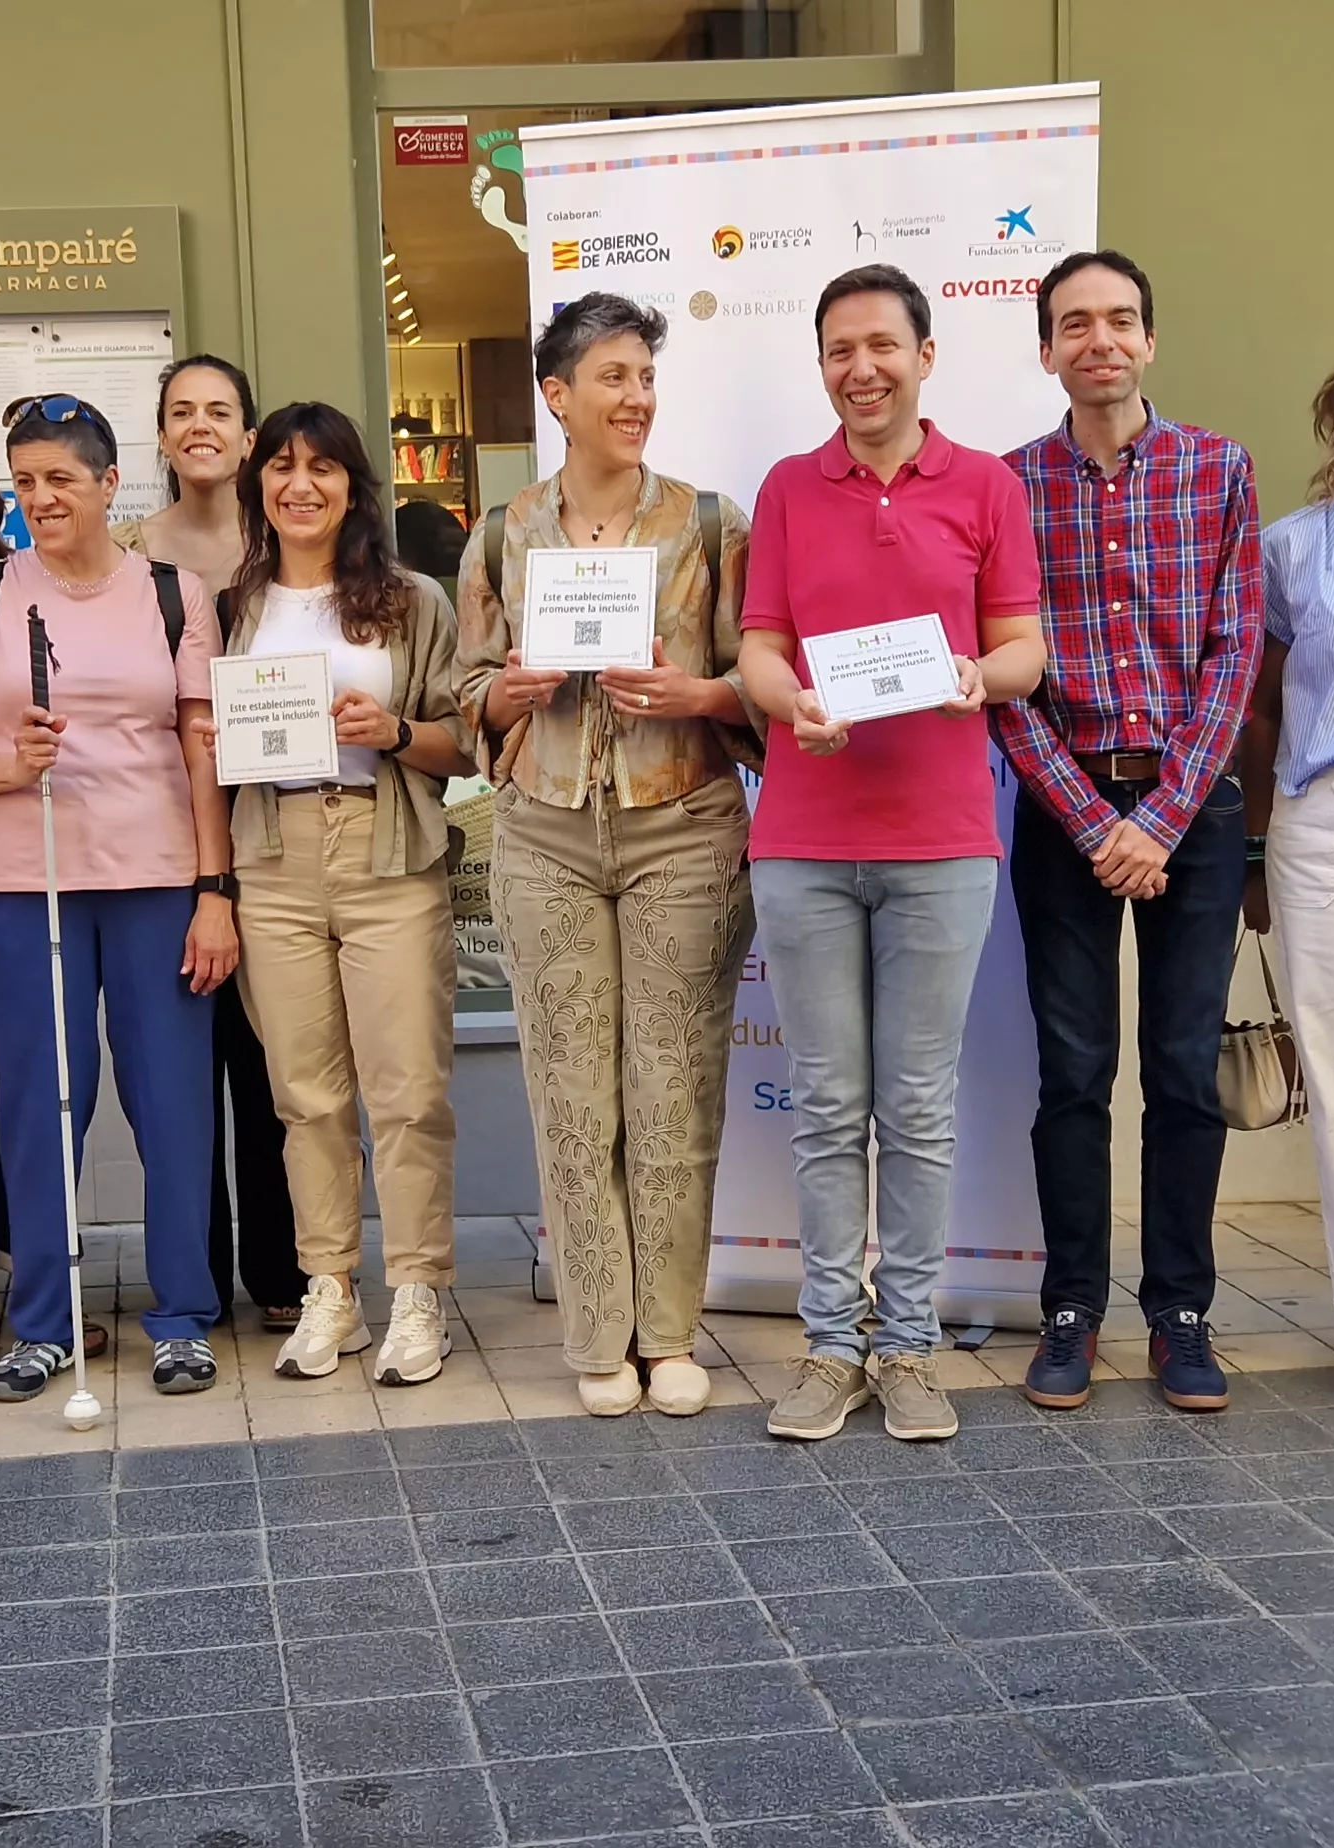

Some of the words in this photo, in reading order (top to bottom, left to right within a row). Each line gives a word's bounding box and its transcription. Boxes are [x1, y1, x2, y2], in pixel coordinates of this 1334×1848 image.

[419, 132, 464, 142] COMERCIO
[419, 141, 464, 152] HUESCA
[546, 209, 602, 222] Colaboran:
[882, 213, 946, 228] Ayuntamiento
[749, 227, 812, 241] DIPUTACIÓN
[882, 229, 894, 239] de
[895, 226, 931, 238] Huesca
[581, 231, 659, 253] GOBIERNO
[749, 237, 812, 250] HUESCA
[581, 254, 600, 269] DE
[604, 247, 671, 268] ARAGON
[968, 245, 1019, 257] Fundación
[941, 277, 1042, 298] avanza
[722, 298, 807, 317] SOBRARBE
[51, 346, 92, 354] FARMACIAS
[104, 345, 137, 353] GUARDIA
[543, 593, 562, 602] Este
[564, 592, 637, 601] establecimiento
[539, 604, 585, 616] promueve
[587, 603, 596, 613] la
[598, 603, 640, 613] inclusión
[830, 663, 851, 673] Este
[853, 648, 930, 668] establecimiento
[829, 666, 879, 683] promueve
[881, 663, 891, 672] la
[893, 655, 937, 669] inclusión
[229, 703, 247, 713] Este
[249, 697, 316, 711] establecimiento
[227, 714, 270, 728] promueve
[271, 711, 280, 722] la
[282, 709, 320, 721] inclusión
